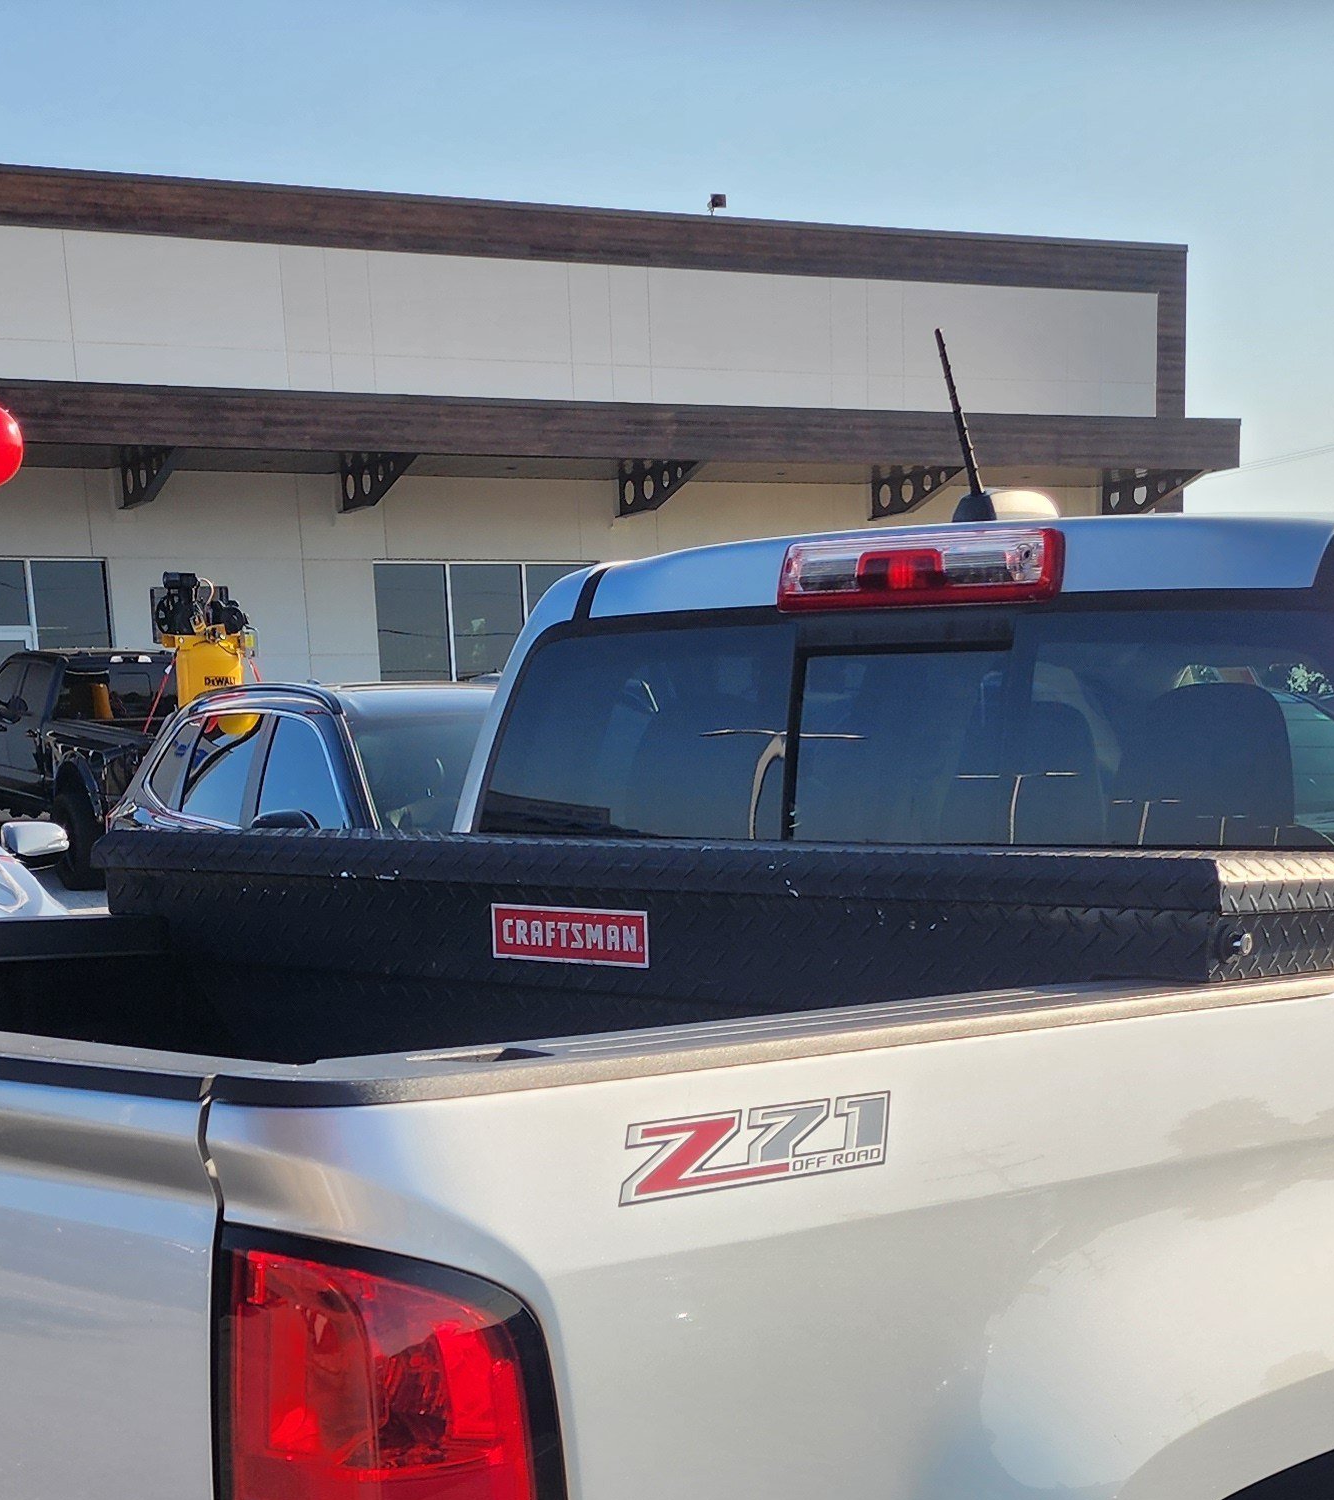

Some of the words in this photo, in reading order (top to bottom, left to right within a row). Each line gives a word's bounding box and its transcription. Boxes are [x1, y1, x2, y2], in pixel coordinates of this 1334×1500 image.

[502, 918, 637, 953] CRAFTSMAN
[618, 1089, 891, 1207] Z71
[792, 1154, 828, 1172] OFF
[832, 1146, 882, 1166] ROAD
